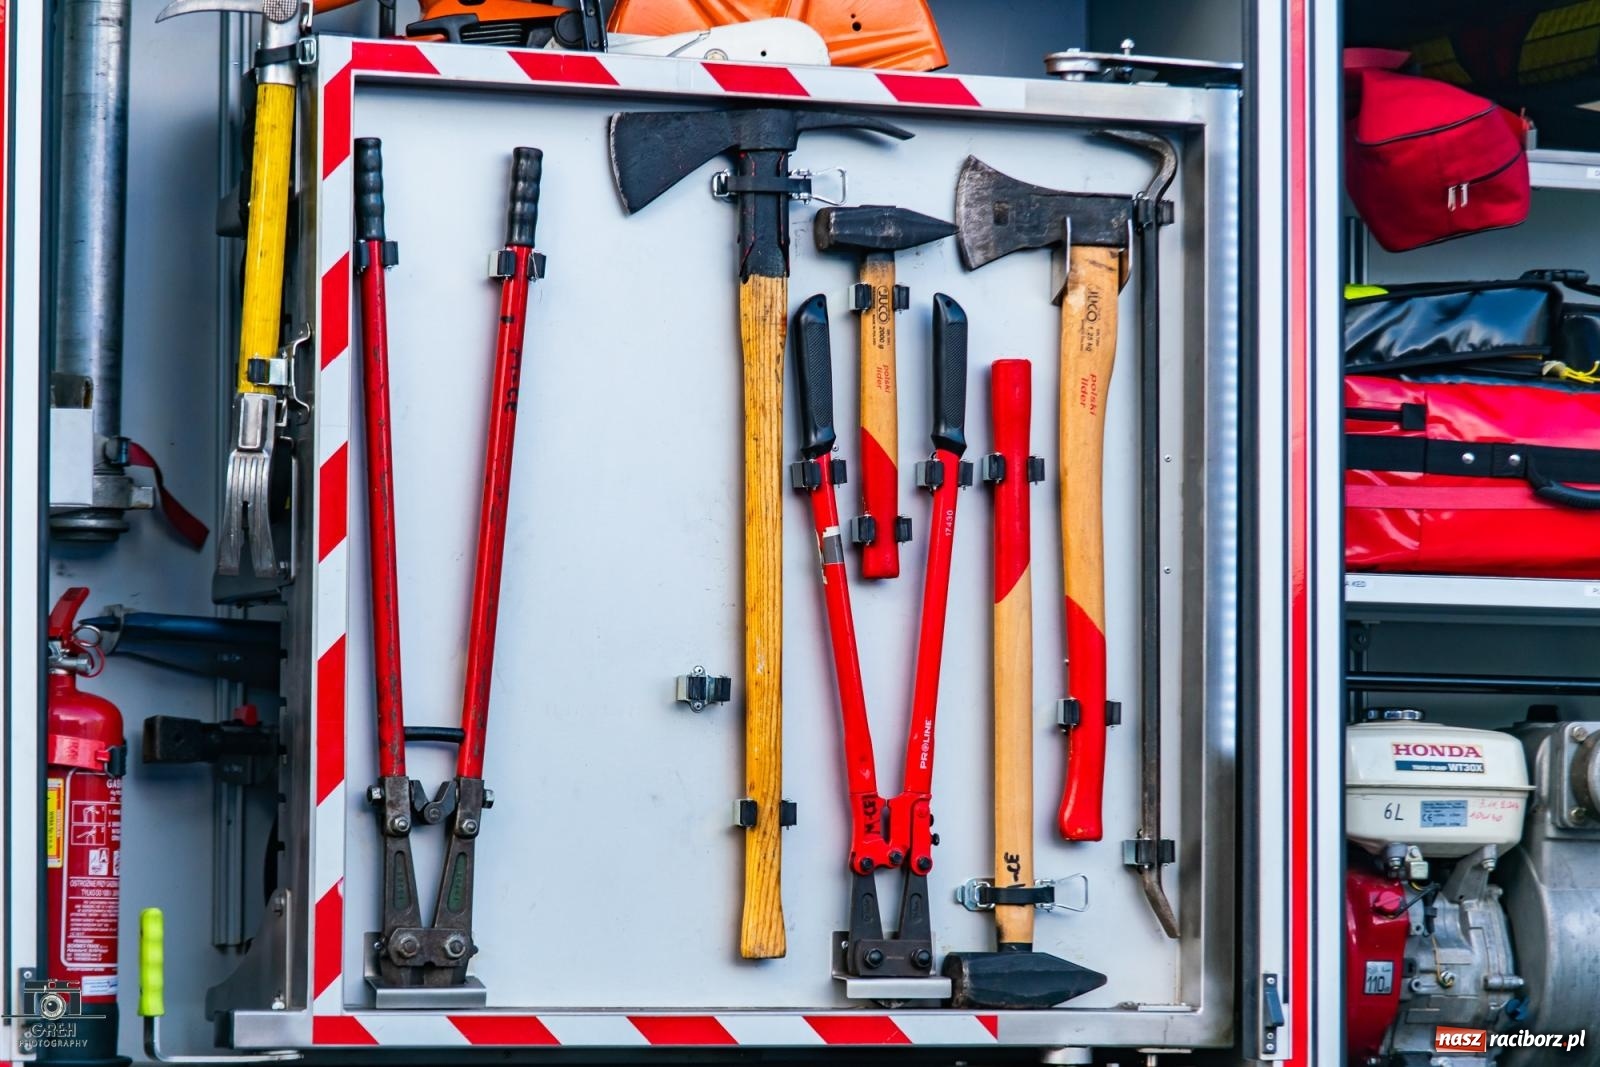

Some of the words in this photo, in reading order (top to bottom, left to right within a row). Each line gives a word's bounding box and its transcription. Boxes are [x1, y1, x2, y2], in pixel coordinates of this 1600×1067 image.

[878, 290, 889, 322] JUCO
[883, 364, 891, 393] polski
[1080, 378, 1088, 408] lider
[1090, 374, 1098, 416] polski
[945, 510, 954, 536] 17430
[920, 720, 932, 769] PROLINE
[1392, 744, 1483, 758] HONDA
[1447, 763, 1483, 772] WT30X
[1367, 976, 1385, 992] 110
